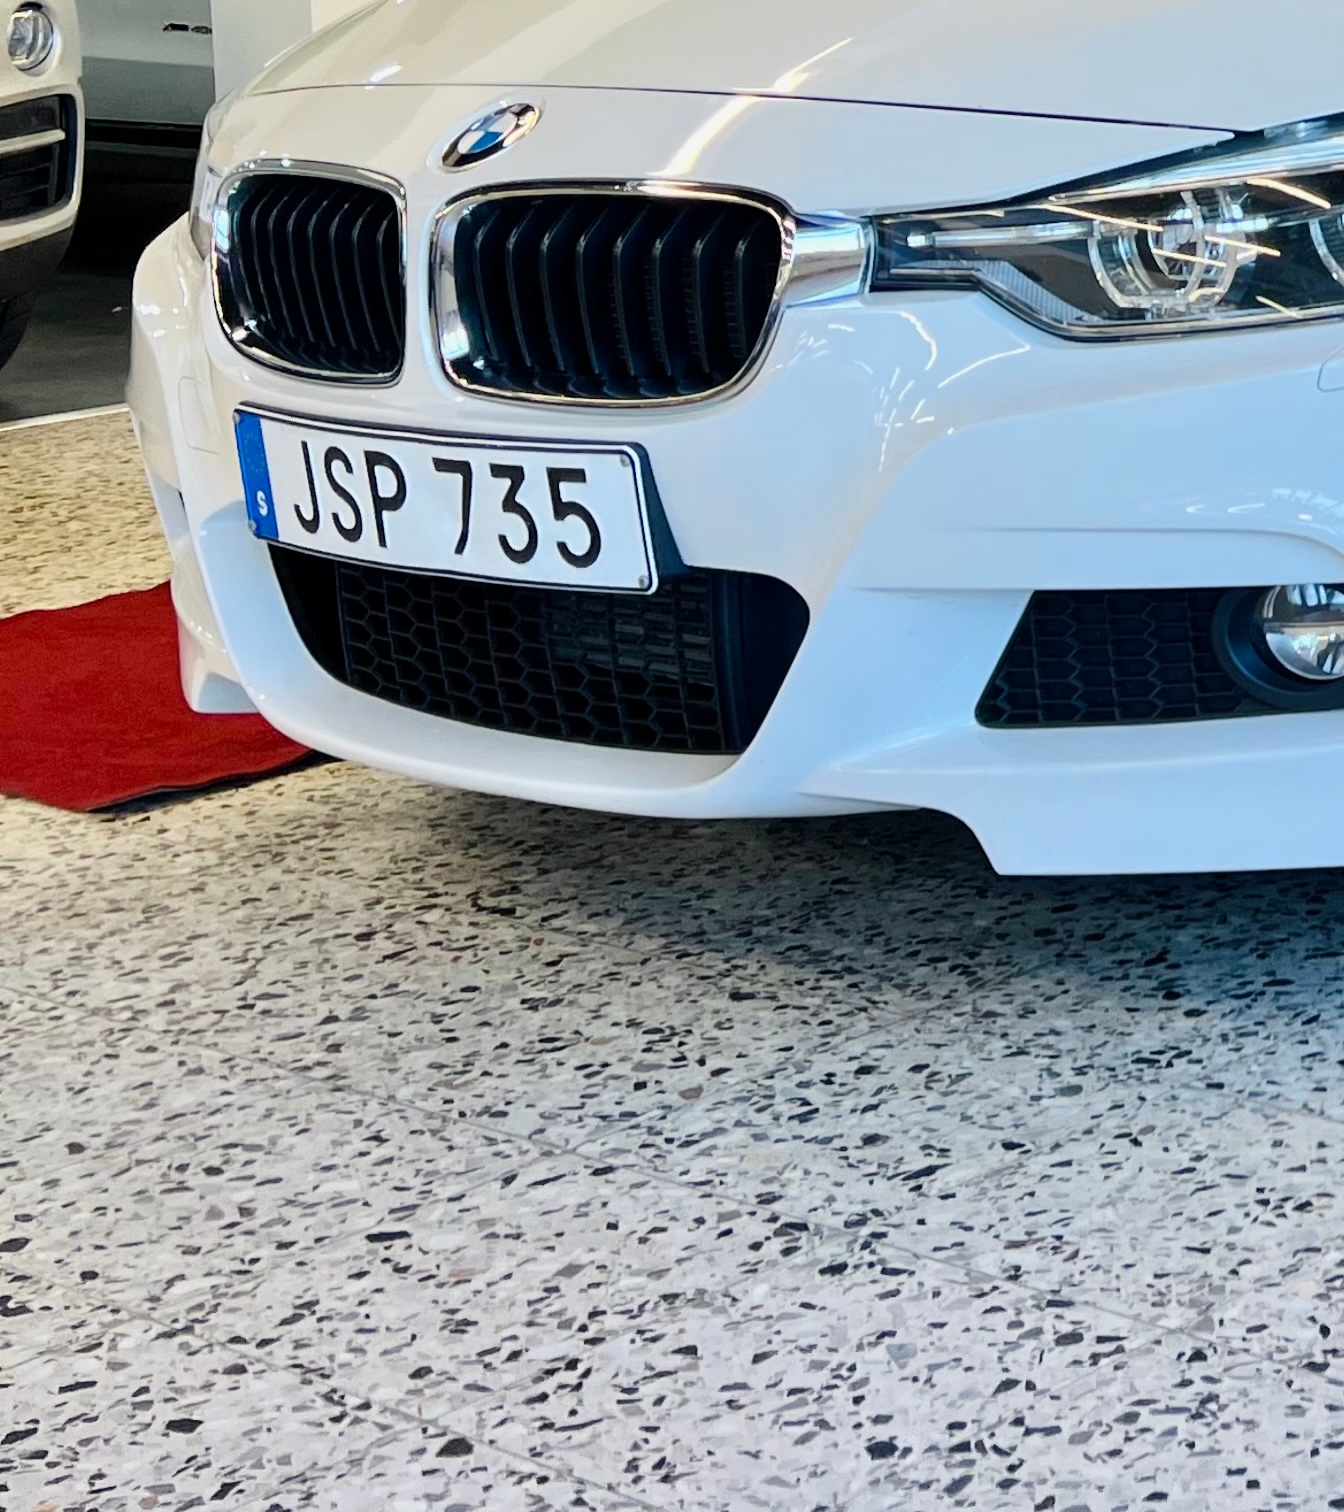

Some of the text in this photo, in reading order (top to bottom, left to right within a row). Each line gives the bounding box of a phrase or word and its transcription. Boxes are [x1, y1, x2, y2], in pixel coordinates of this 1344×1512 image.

[257, 490, 268, 516] S
[294, 440, 601, 569] JSP 735
